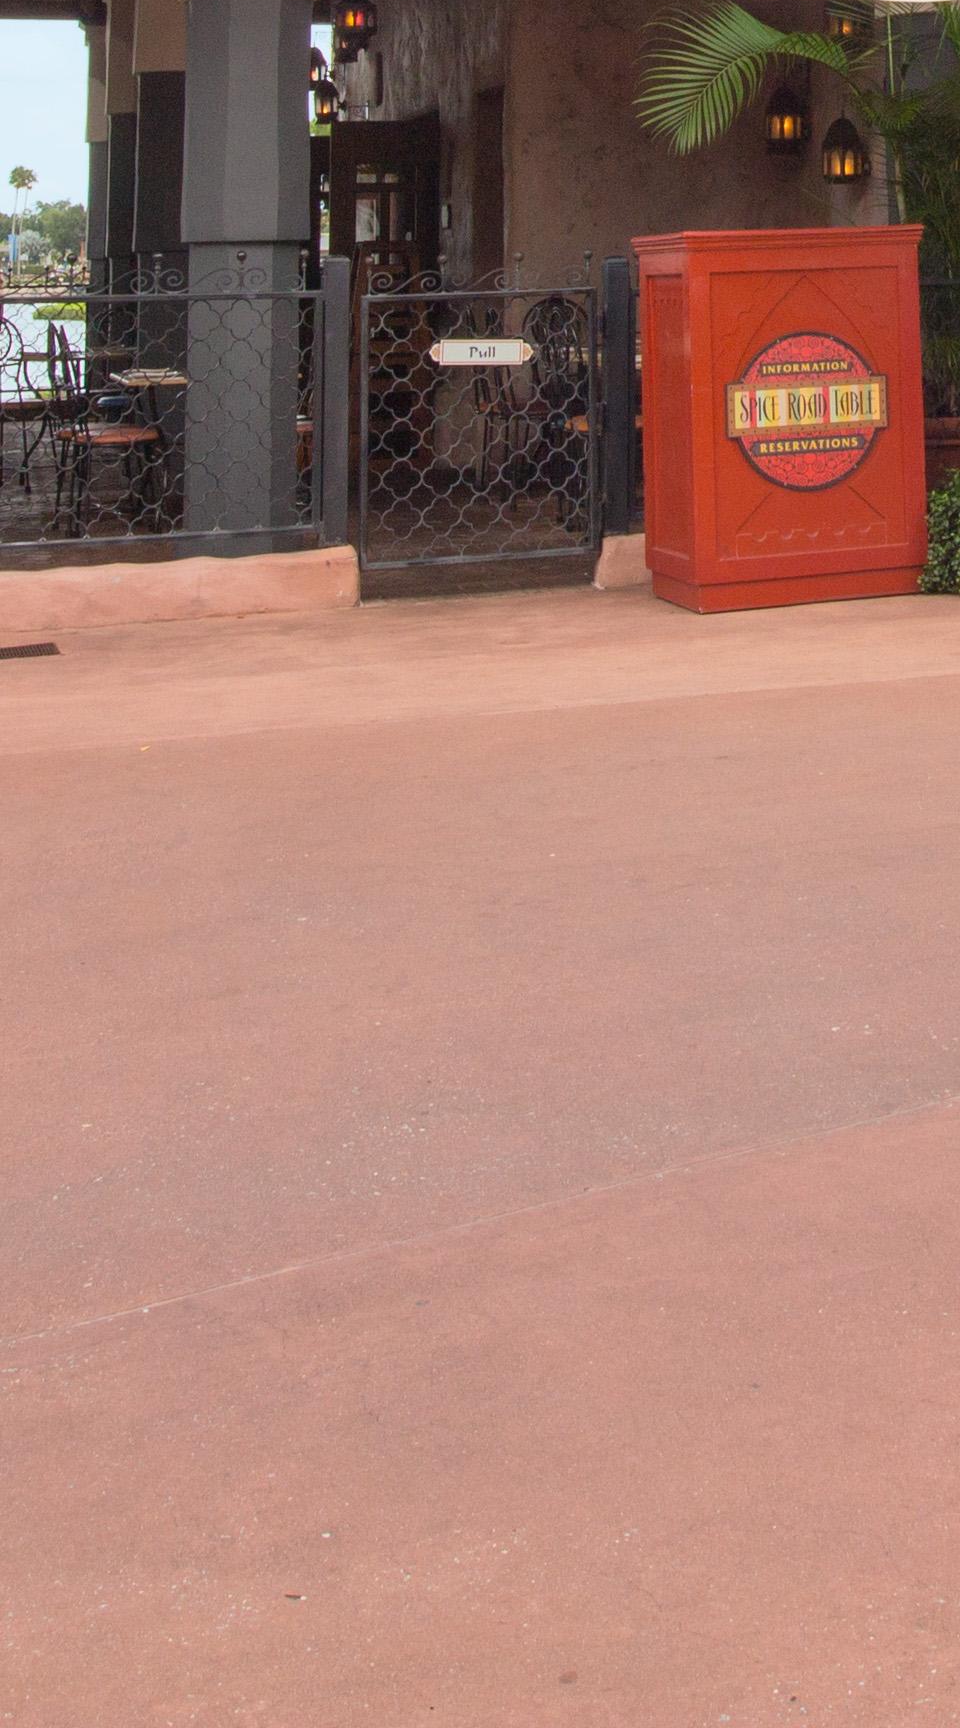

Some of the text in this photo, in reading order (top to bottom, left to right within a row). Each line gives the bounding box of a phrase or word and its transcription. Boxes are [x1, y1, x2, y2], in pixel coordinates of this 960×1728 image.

[469, 346, 496, 358] Pull
[762, 361, 848, 374] INFORMATION
[740, 389, 877, 423] SPICE ROAD TABLE
[760, 437, 858, 453] RESERVATIONS
